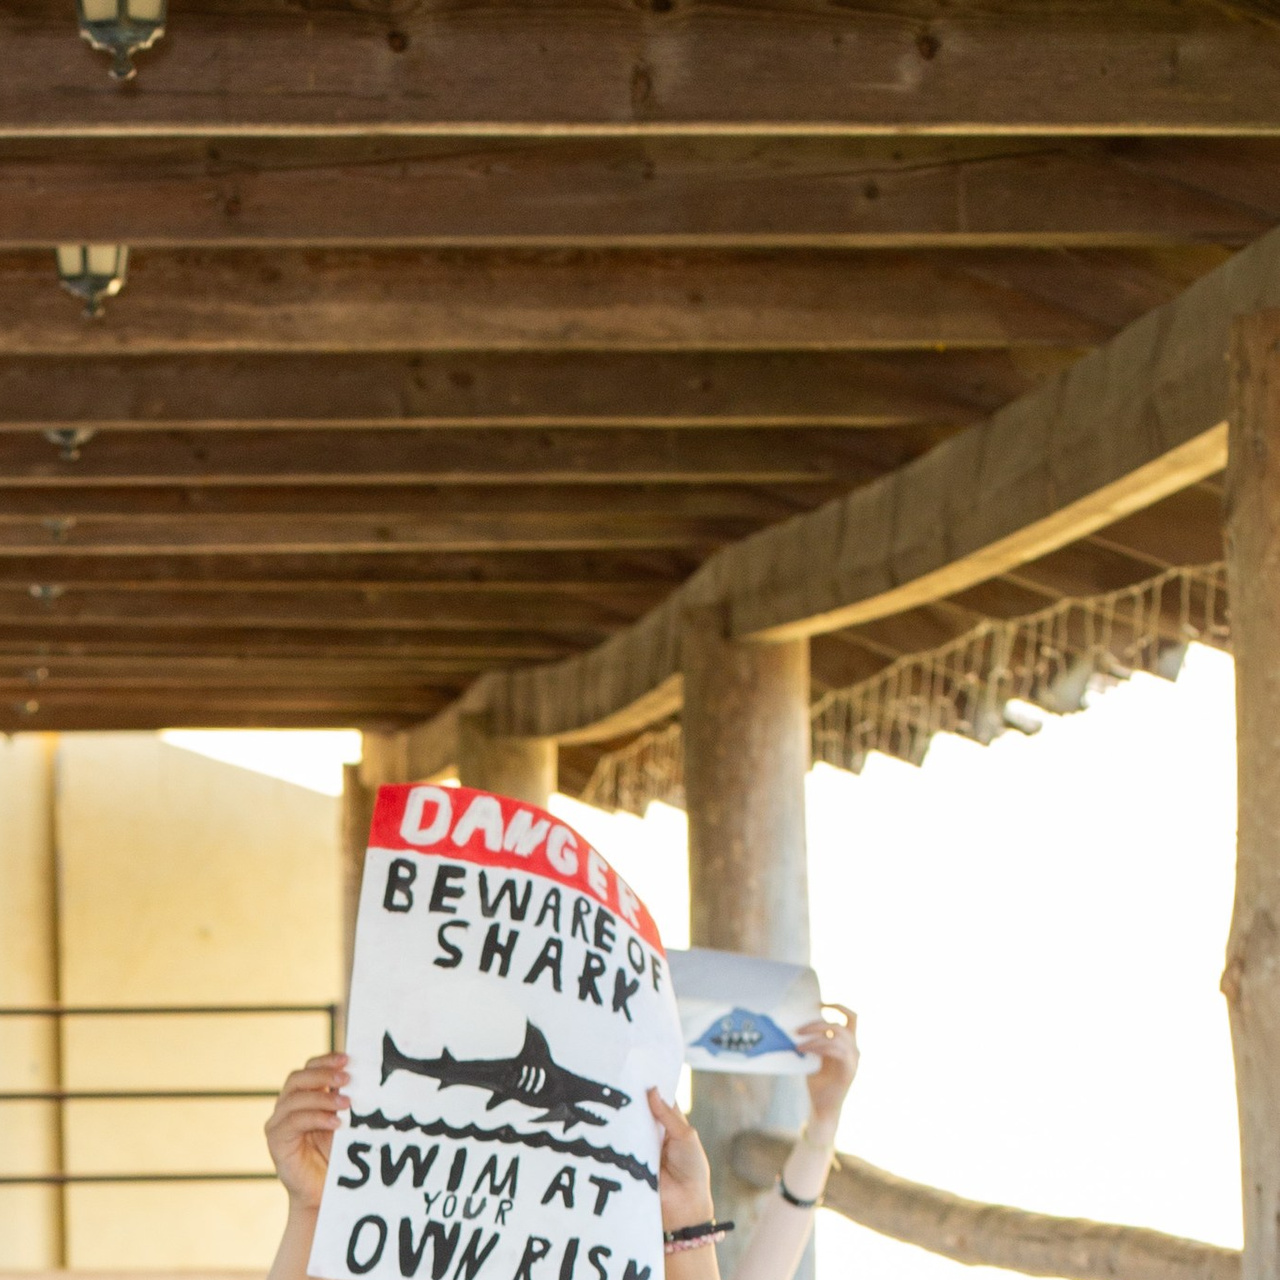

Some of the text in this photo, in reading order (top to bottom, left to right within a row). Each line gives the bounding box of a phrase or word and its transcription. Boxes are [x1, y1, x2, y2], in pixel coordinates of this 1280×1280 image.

[399, 786, 643, 932] DANGER
[383, 858, 663, 992] BEWARE OF
[434, 920, 640, 1023] SHARK
[338, 1143, 622, 1217] SWIM AT
[424, 1191, 514, 1226] YOUR
